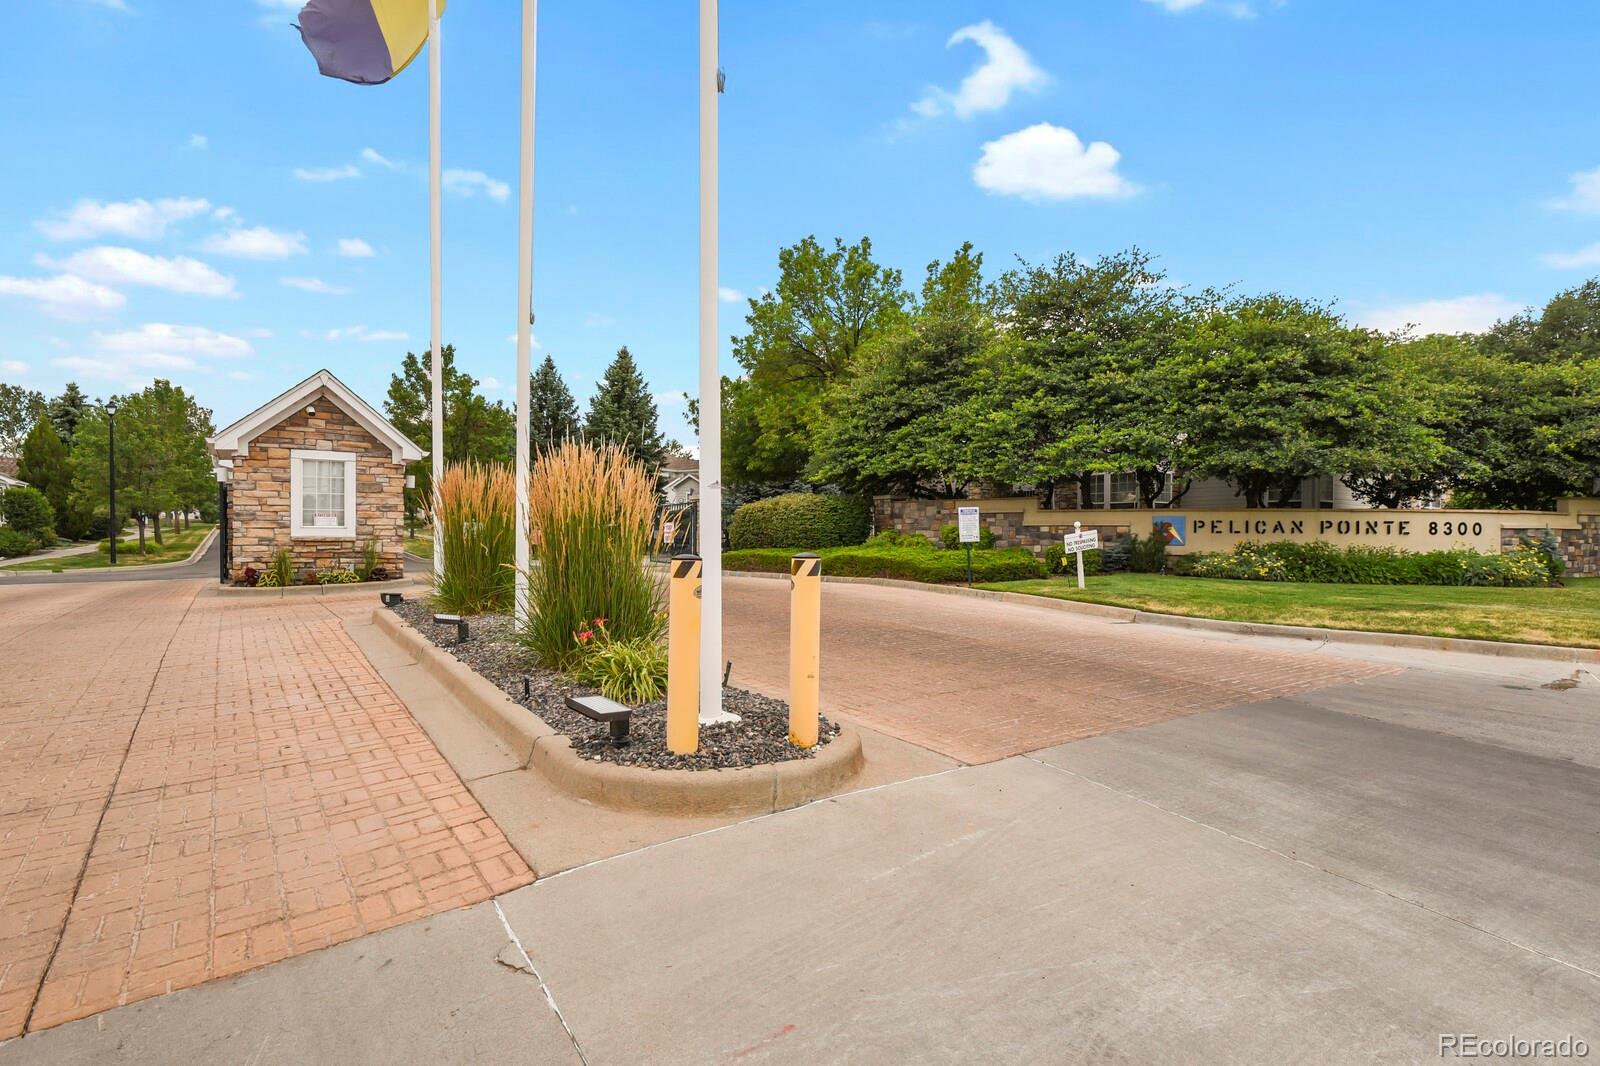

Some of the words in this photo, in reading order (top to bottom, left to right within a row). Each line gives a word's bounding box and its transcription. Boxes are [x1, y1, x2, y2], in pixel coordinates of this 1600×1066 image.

[1193, 519, 1304, 534] PELICAN
[1319, 520, 1410, 535] POINTE
[1428, 521, 1483, 536] 8300
